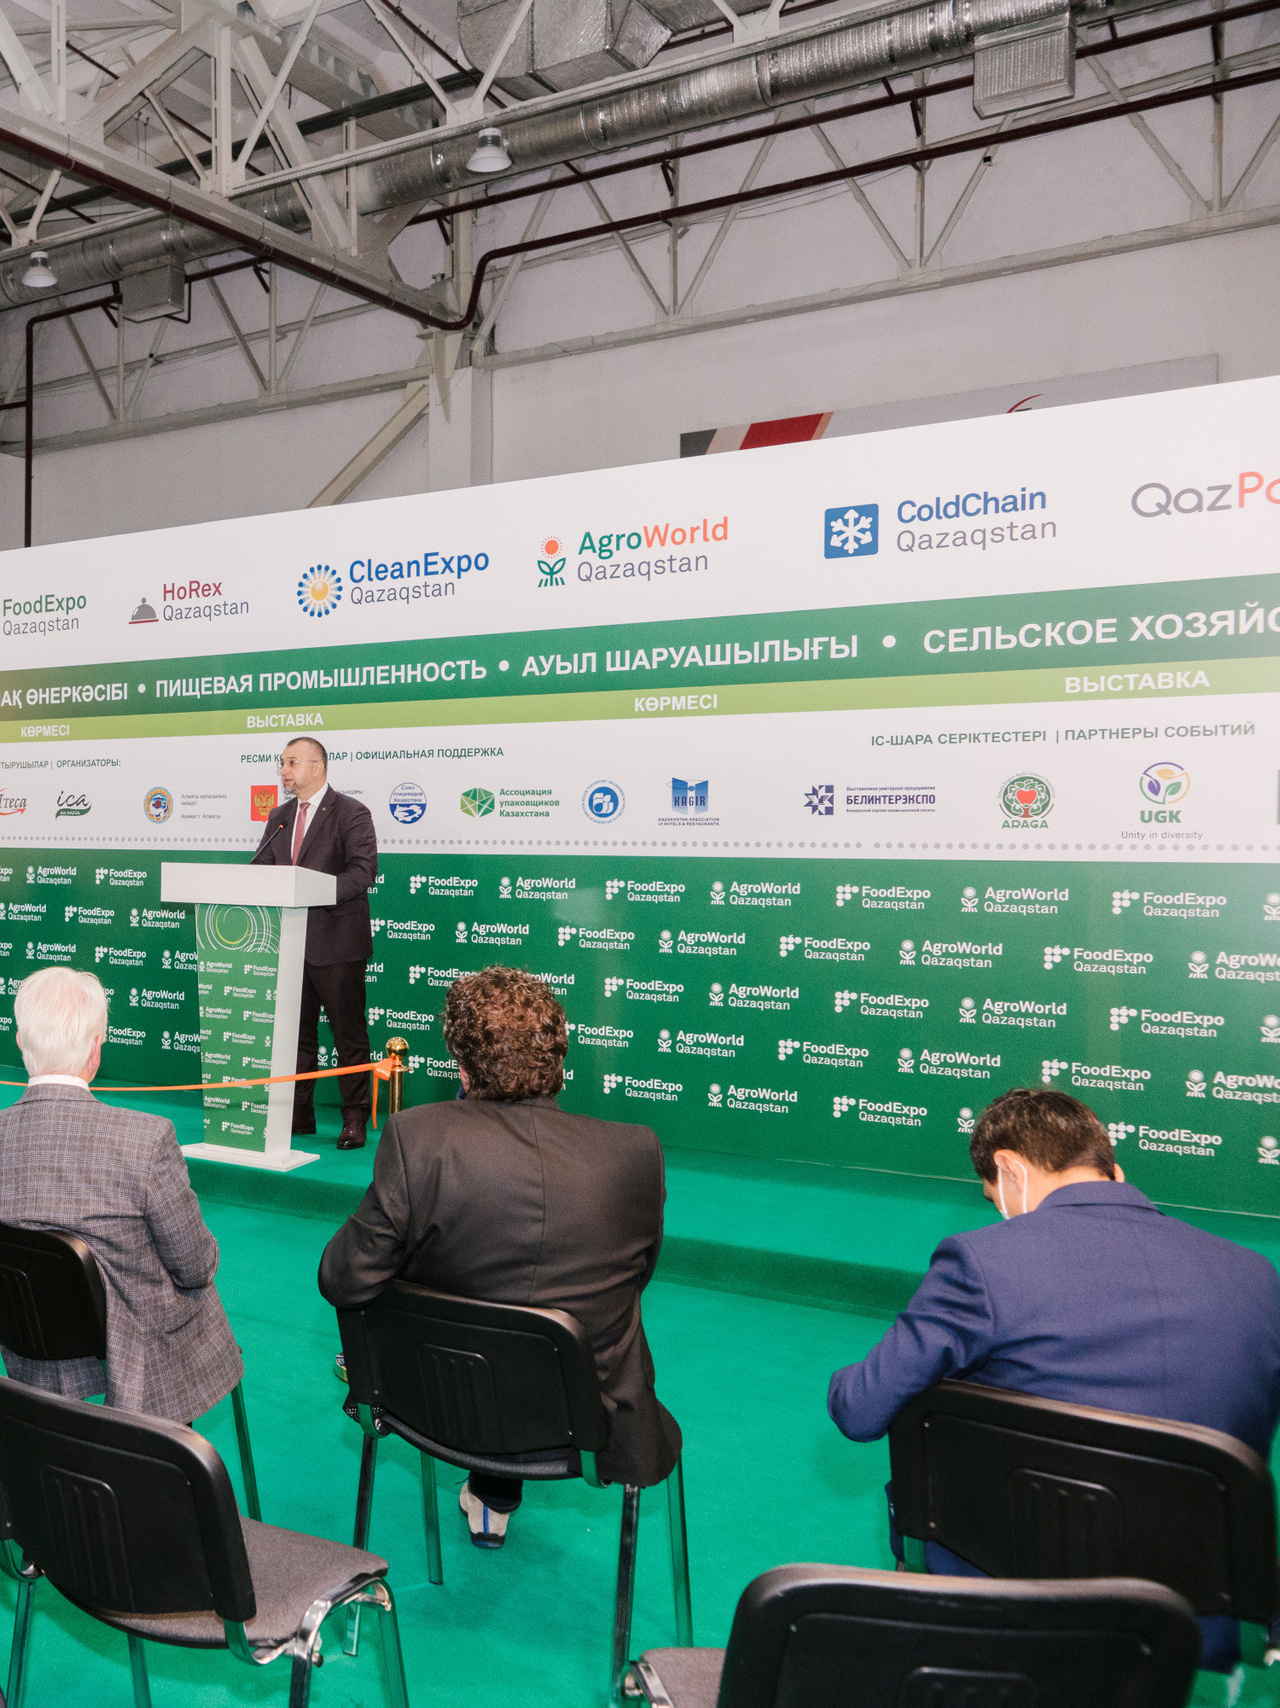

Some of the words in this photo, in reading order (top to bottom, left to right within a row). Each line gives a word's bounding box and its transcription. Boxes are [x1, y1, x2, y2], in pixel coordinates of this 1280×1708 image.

[898, 487, 1046, 523] ColdChain
[578, 516, 728, 560] AgroWorld
[897, 522, 1056, 552] Qazaqstan
[350, 552, 489, 583] CleanExpo
[578, 555, 707, 582] Qazaqstan
[164, 580, 222, 601] HoRex
[351, 582, 454, 604] Qazaqstan
[3, 594, 86, 616] FoodExpo
[163, 601, 248, 621] Qazaqstan
[3, 617, 79, 636] Qazaqstan
[26, 683, 127, 705] ӨНЕРКӘСІБІ
[156, 674, 252, 698] ПИЩЕВАЯ
[260, 660, 487, 691] ПРОМЫШЛЕННОСТЬ
[522, 652, 596, 676] АУЫЛ
[606, 635, 857, 671] ШАРУАШЫЛЫҒЫ
[924, 618, 1117, 653] СЕЛЬСКОЕ
[1066, 671, 1210, 693] ВЫСТАВКА
[635, 694, 717, 712] КӨРМЕСІ
[247, 713, 323, 728] ВЫСТАВКА
[21, 725, 69, 737] КӨРМЕСІ
[938, 731, 1046, 744] СЕРІКТЕСТЕРІ
[1065, 727, 1158, 740] ПАРТНЕРЫ
[1164, 722, 1254, 738] СОБЫТИЙ
[241, 754, 271, 763] РЕСМИ
[356, 749, 434, 760] ОФИЦИАЛЬНАЯ
[438, 748, 504, 759] ПОДДЕРЖКА
[56, 759, 120, 768] ОРГАНИЗАТОРЫ:
[500, 788, 552, 796] Ассоциация
[846, 794, 935, 804] БЕЛИНТЕРЭКСПО
[500, 800, 560, 808] упаковщиков
[1140, 810, 1181, 823] UGK
[1002, 820, 1048, 828] ARAGA
[1122, 831, 1146, 840] Unity
[1161, 831, 1203, 840] diversity
[110, 869, 147, 880] FoodExpo
[110, 878, 144, 887] Qazaqstan
[429, 876, 478, 888] FoodExpo
[730, 882, 800, 896] AgroWorld
[429, 887, 473, 897] Qazaqstan
[862, 886, 930, 900] FoodExpo
[985, 887, 1069, 902] AgroWorld
[730, 895, 791, 908] Qazaqstan
[862, 898, 924, 911] Qazaqstan
[78, 907, 114, 918] FoodExpo
[142, 908, 185, 920] AgroWorld
[984, 902, 1058, 916] Qazaqstan
[78, 916, 111, 925] Qazaqstan
[142, 919, 179, 929] Qazaqstan
[388, 920, 435, 932] FoodExpo
[387, 930, 430, 941] Qazaqstan
[579, 928, 634, 942] FoodExpo
[37, 942, 76, 953] AgroWorld
[579, 939, 630, 950] Qazaqstan
[805, 937, 870, 952] FoodExpo
[37, 952, 71, 962] Qazaqstan
[805, 949, 864, 962] Qazaqstan
[1074, 948, 1153, 964] FoodExpo
[1074, 961, 1146, 975] Qazaqstan
[626, 979, 684, 994] FoodExpo
[729, 984, 799, 998] AgroWorld
[142, 988, 184, 1000] AgroWorld
[626, 990, 678, 1002] Qazaqstan
[861, 993, 929, 1009] FoodExpo
[141, 999, 179, 1010] Qazaqstan
[728, 997, 790, 1010] Qazaqstan
[386, 1009, 434, 1023] FoodExpo
[861, 1005, 922, 1019] Qazaqstan
[1142, 1009, 1224, 1027] FoodExpo
[386, 1019, 430, 1031] Qazaqstan
[1141, 1023, 1216, 1038] Qazaqstan
[677, 1030, 744, 1046] AgroWorld
[676, 1043, 735, 1058] Qazaqstan
[920, 1049, 1000, 1066] AgroWorld
[920, 1063, 990, 1079] Qazaqstan
[626, 1076, 683, 1093] FoodExpo
[625, 1088, 678, 1101] Qazaqstan
[859, 1099, 927, 1117] FoodExpo
[859, 1111, 921, 1126] Qazaqstan
[1139, 1126, 1222, 1146] FoodExpo
[1139, 1139, 1214, 1156] Qazaqstan
